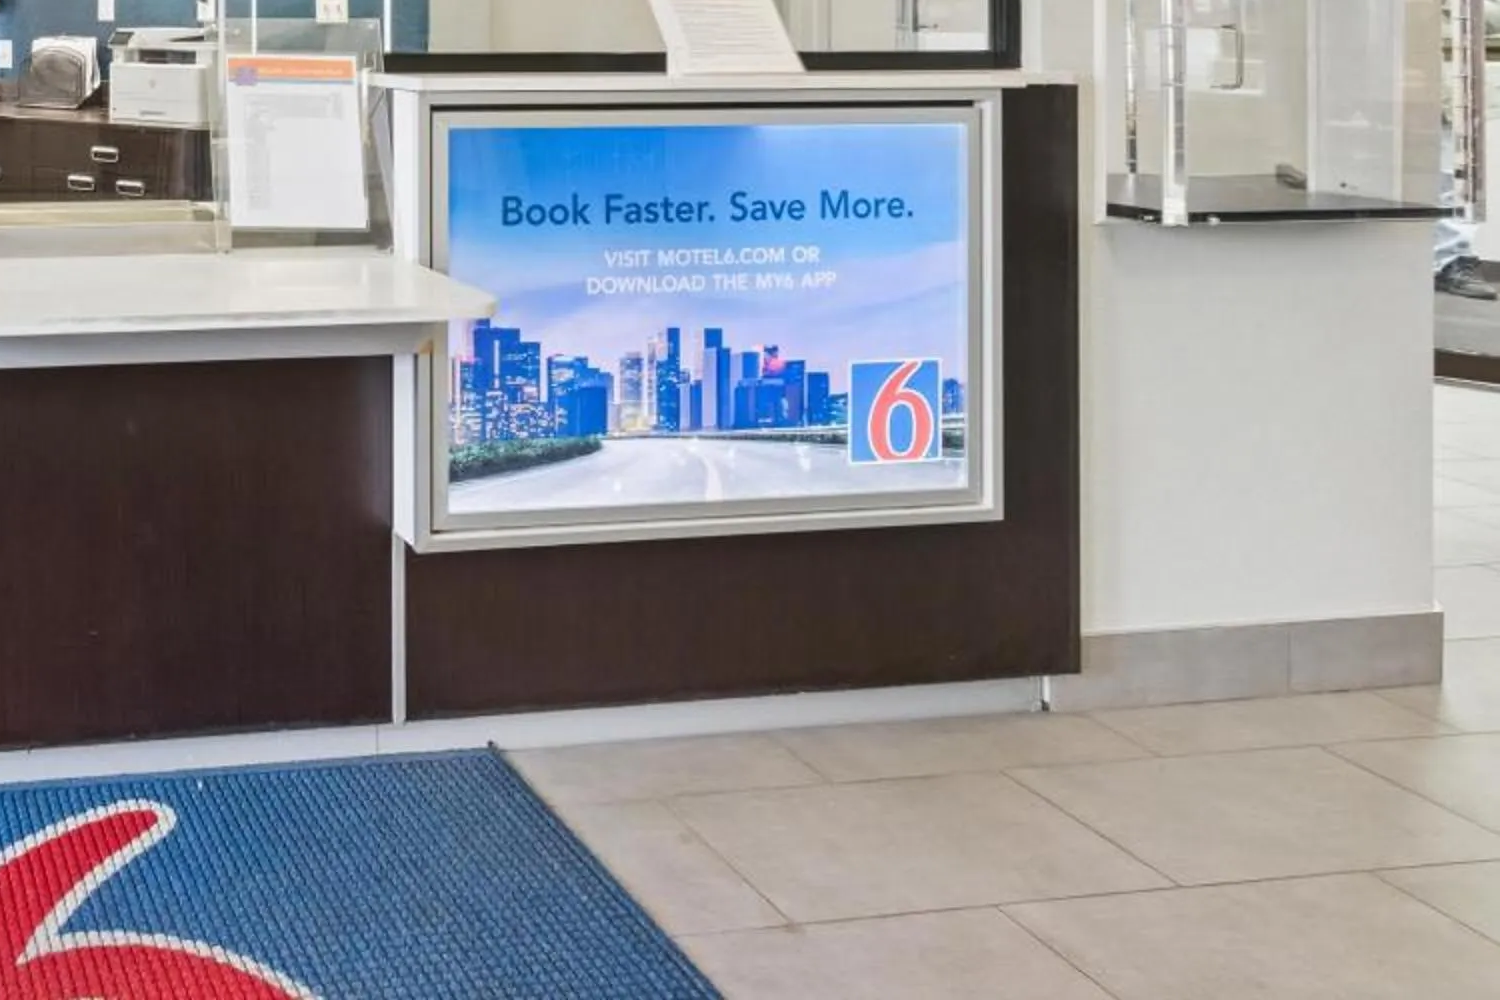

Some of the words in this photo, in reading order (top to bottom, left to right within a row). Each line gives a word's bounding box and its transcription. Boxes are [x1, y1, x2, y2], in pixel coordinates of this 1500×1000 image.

[501, 192, 591, 227] Book
[604, 193, 715, 225] Faster.
[729, 191, 806, 222] Save
[820, 189, 913, 220] More.
[603, 249, 651, 268] VISIT
[657, 246, 785, 267] MOTEL6.COM
[791, 245, 820, 264] OR
[586, 273, 706, 295] DOWNLOAD
[713, 272, 751, 291] THE
[755, 272, 794, 290] MY6
[801, 270, 837, 288] APP
[868, 358, 934, 463] 6
